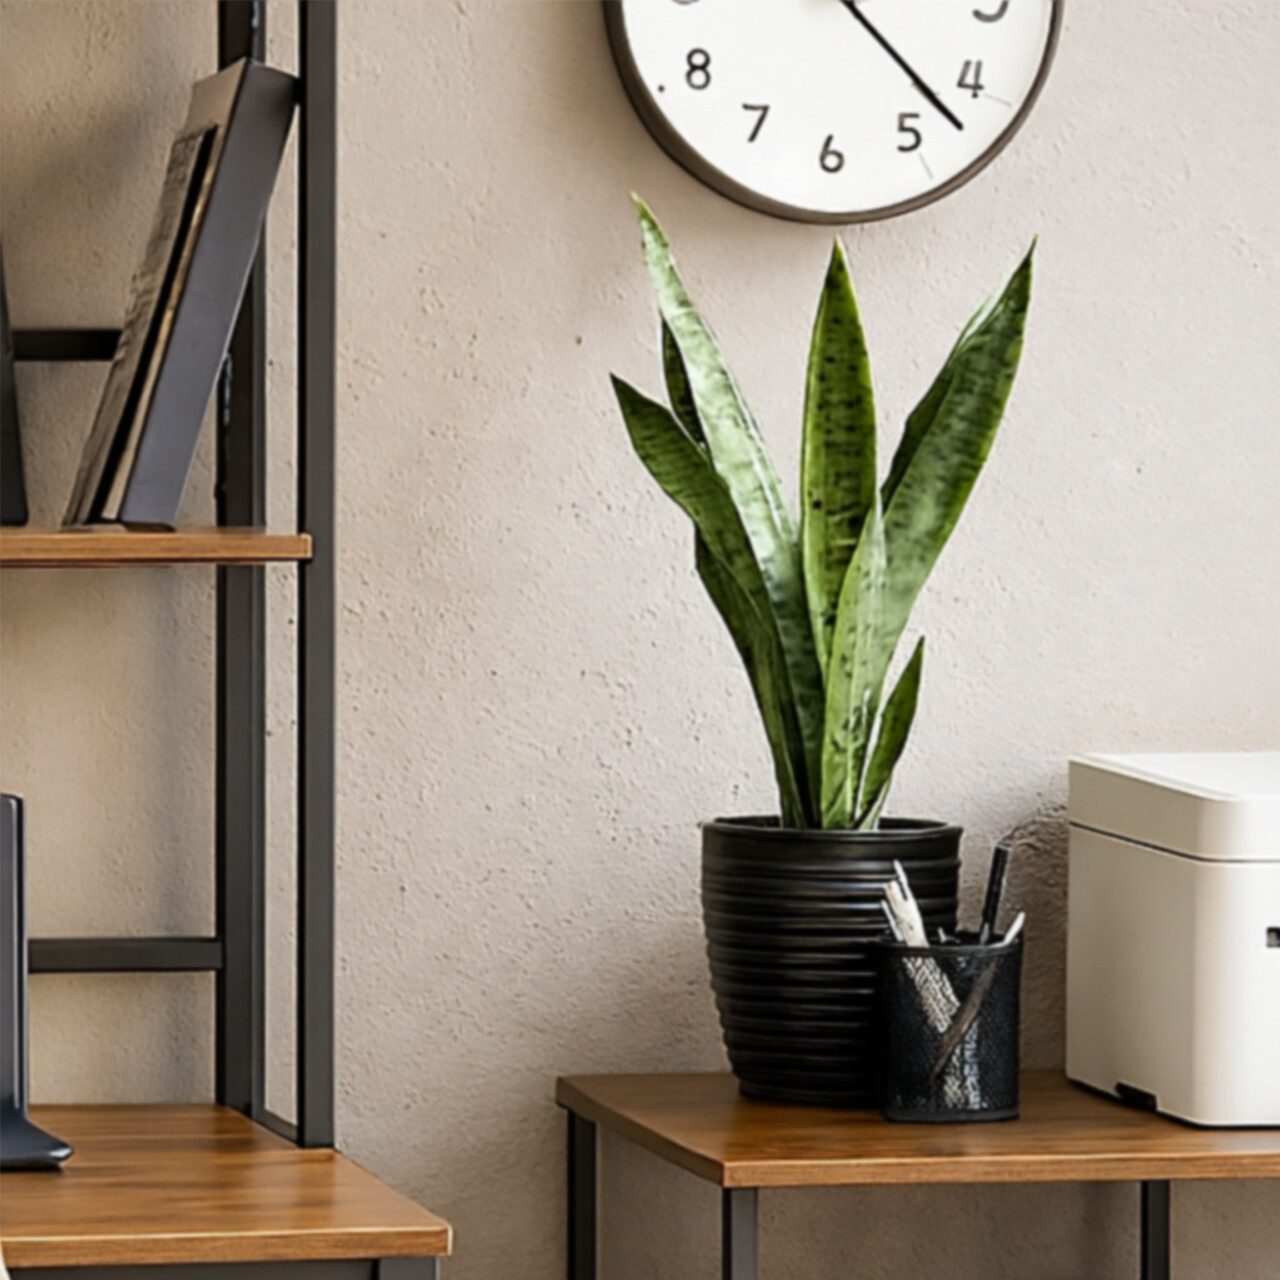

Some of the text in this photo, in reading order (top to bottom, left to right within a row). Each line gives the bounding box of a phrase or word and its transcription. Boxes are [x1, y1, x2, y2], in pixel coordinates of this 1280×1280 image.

[685, 47, 711, 90] 8
[957, 60, 984, 99] 4
[742, 103, 770, 143] 7
[897, 112, 922, 153] 5
[819, 134, 844, 173] 6
